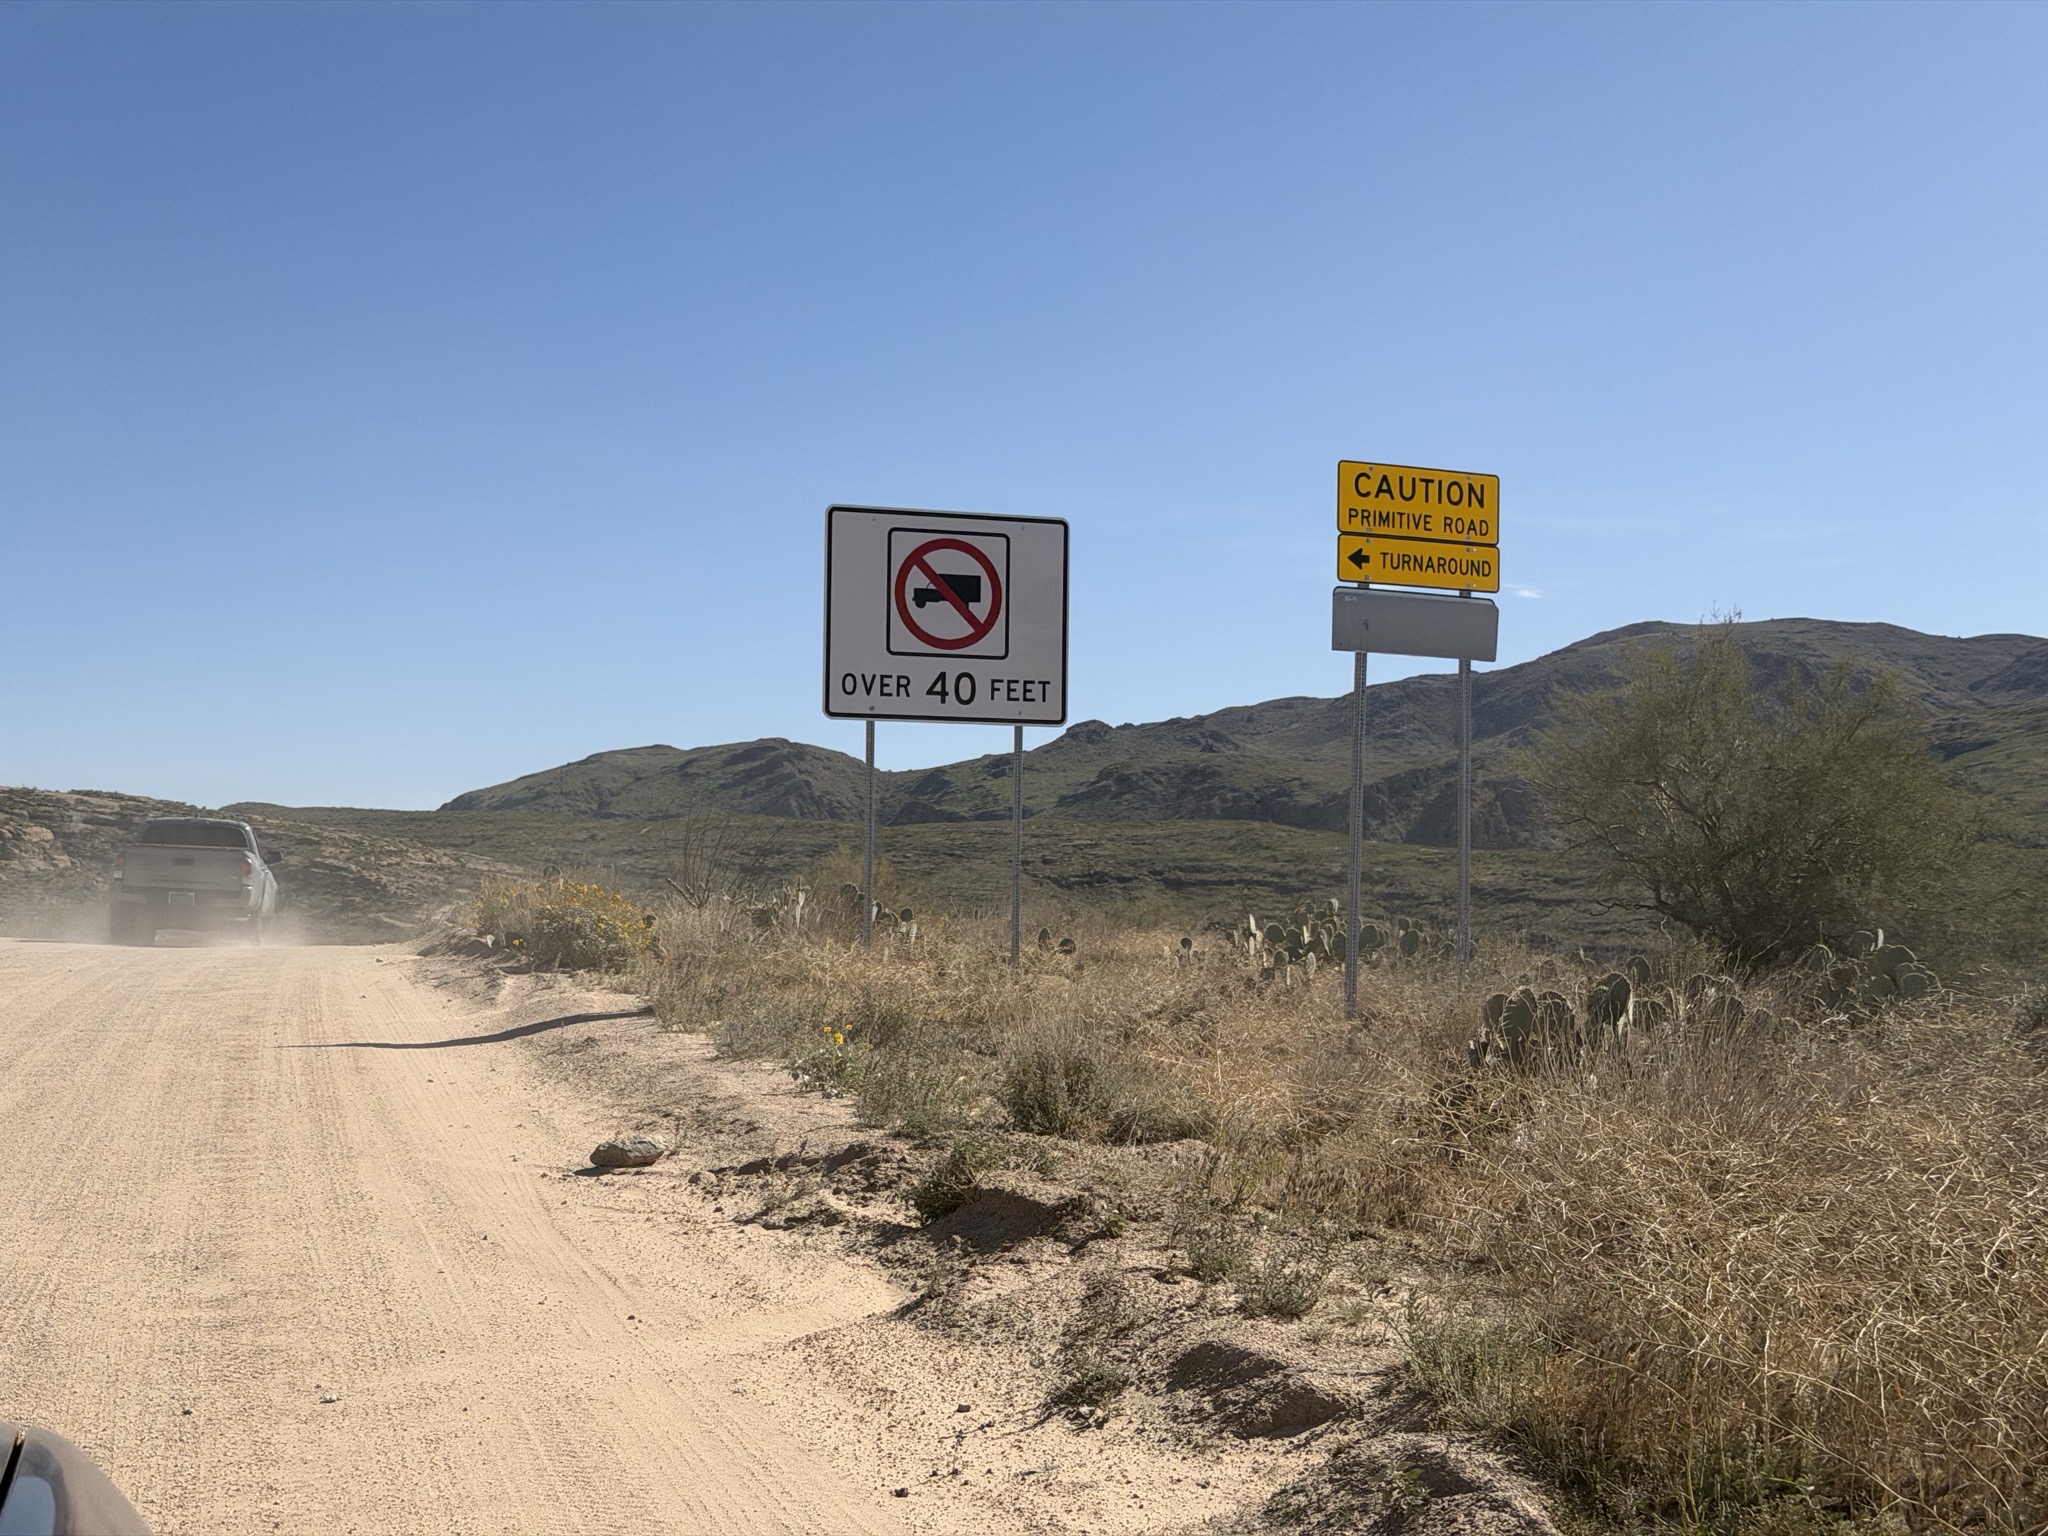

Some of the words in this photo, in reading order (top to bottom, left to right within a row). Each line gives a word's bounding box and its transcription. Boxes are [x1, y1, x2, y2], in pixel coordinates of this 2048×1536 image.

[1354, 472, 1485, 508] CAUTION
[1348, 508, 1432, 531] PRIMITIVE
[1444, 516, 1489, 536] ROAD
[1380, 552, 1491, 577] TURNAROUND
[842, 673, 911, 697] OVER
[925, 671, 976, 705] 40
[990, 679, 1051, 702] FEET
